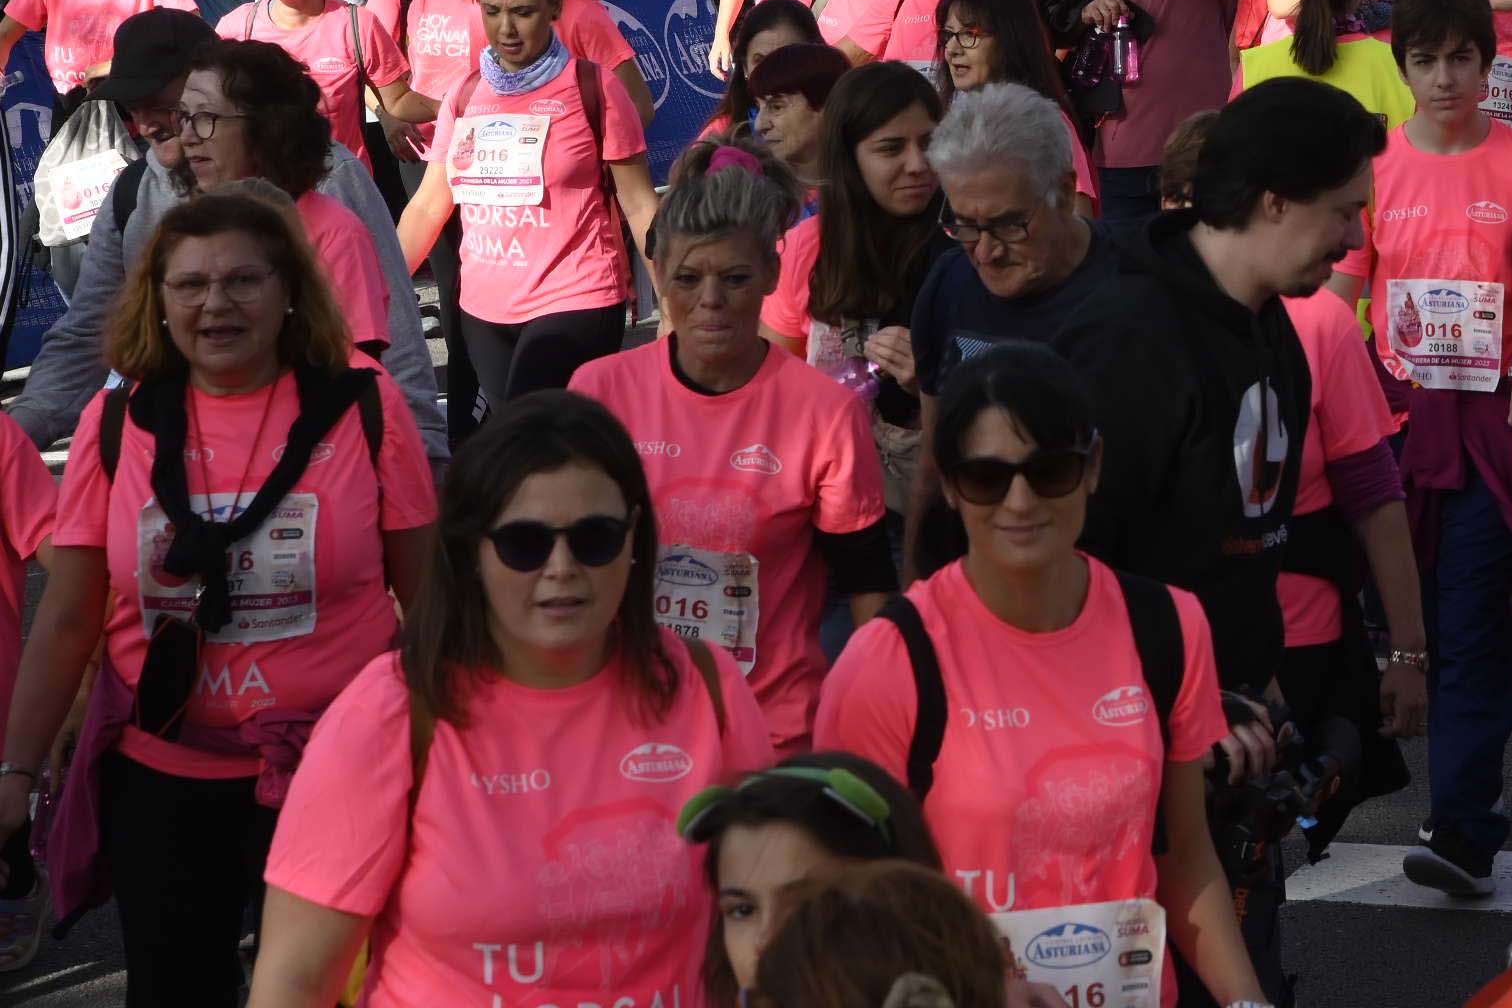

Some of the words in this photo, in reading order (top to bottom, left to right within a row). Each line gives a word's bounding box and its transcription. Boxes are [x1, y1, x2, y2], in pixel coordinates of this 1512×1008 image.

[418, 14, 451, 28] HOY
[416, 43, 442, 56] LAS
[445, 44, 470, 57] CH
[1493, 101, 1512, 111] 13241
[477, 149, 509, 162] 016
[479, 166, 504, 175] 29222
[463, 204, 551, 228] DORSAL
[1382, 205, 1429, 222] OYSHO
[466, 230, 526, 259] SUMA
[1421, 297, 1465, 309] ASTURIANA
[1472, 296, 1497, 305] SUMA
[1425, 322, 1463, 339] 016
[1428, 342, 1458, 353] 20188
[1431, 356, 1440, 365] DE
[1440, 357, 1450, 365] LA
[1456, 373, 1493, 383] Santander
[635, 441, 681, 458] YSHO
[270, 509, 305, 520] SUMA
[224, 550, 255, 572] 16
[239, 597, 273, 607] MUJER
[655, 595, 709, 620] 016
[251, 612, 305, 630] Santander
[659, 623, 701, 638] 1878
[203, 657, 271, 697] MA
[955, 869, 1016, 913] TU
[1117, 924, 1149, 938] SUMA
[1033, 943, 1106, 961] ASTURIANA
[472, 941, 545, 985] TU
[1063, 981, 1106, 1008] 16
